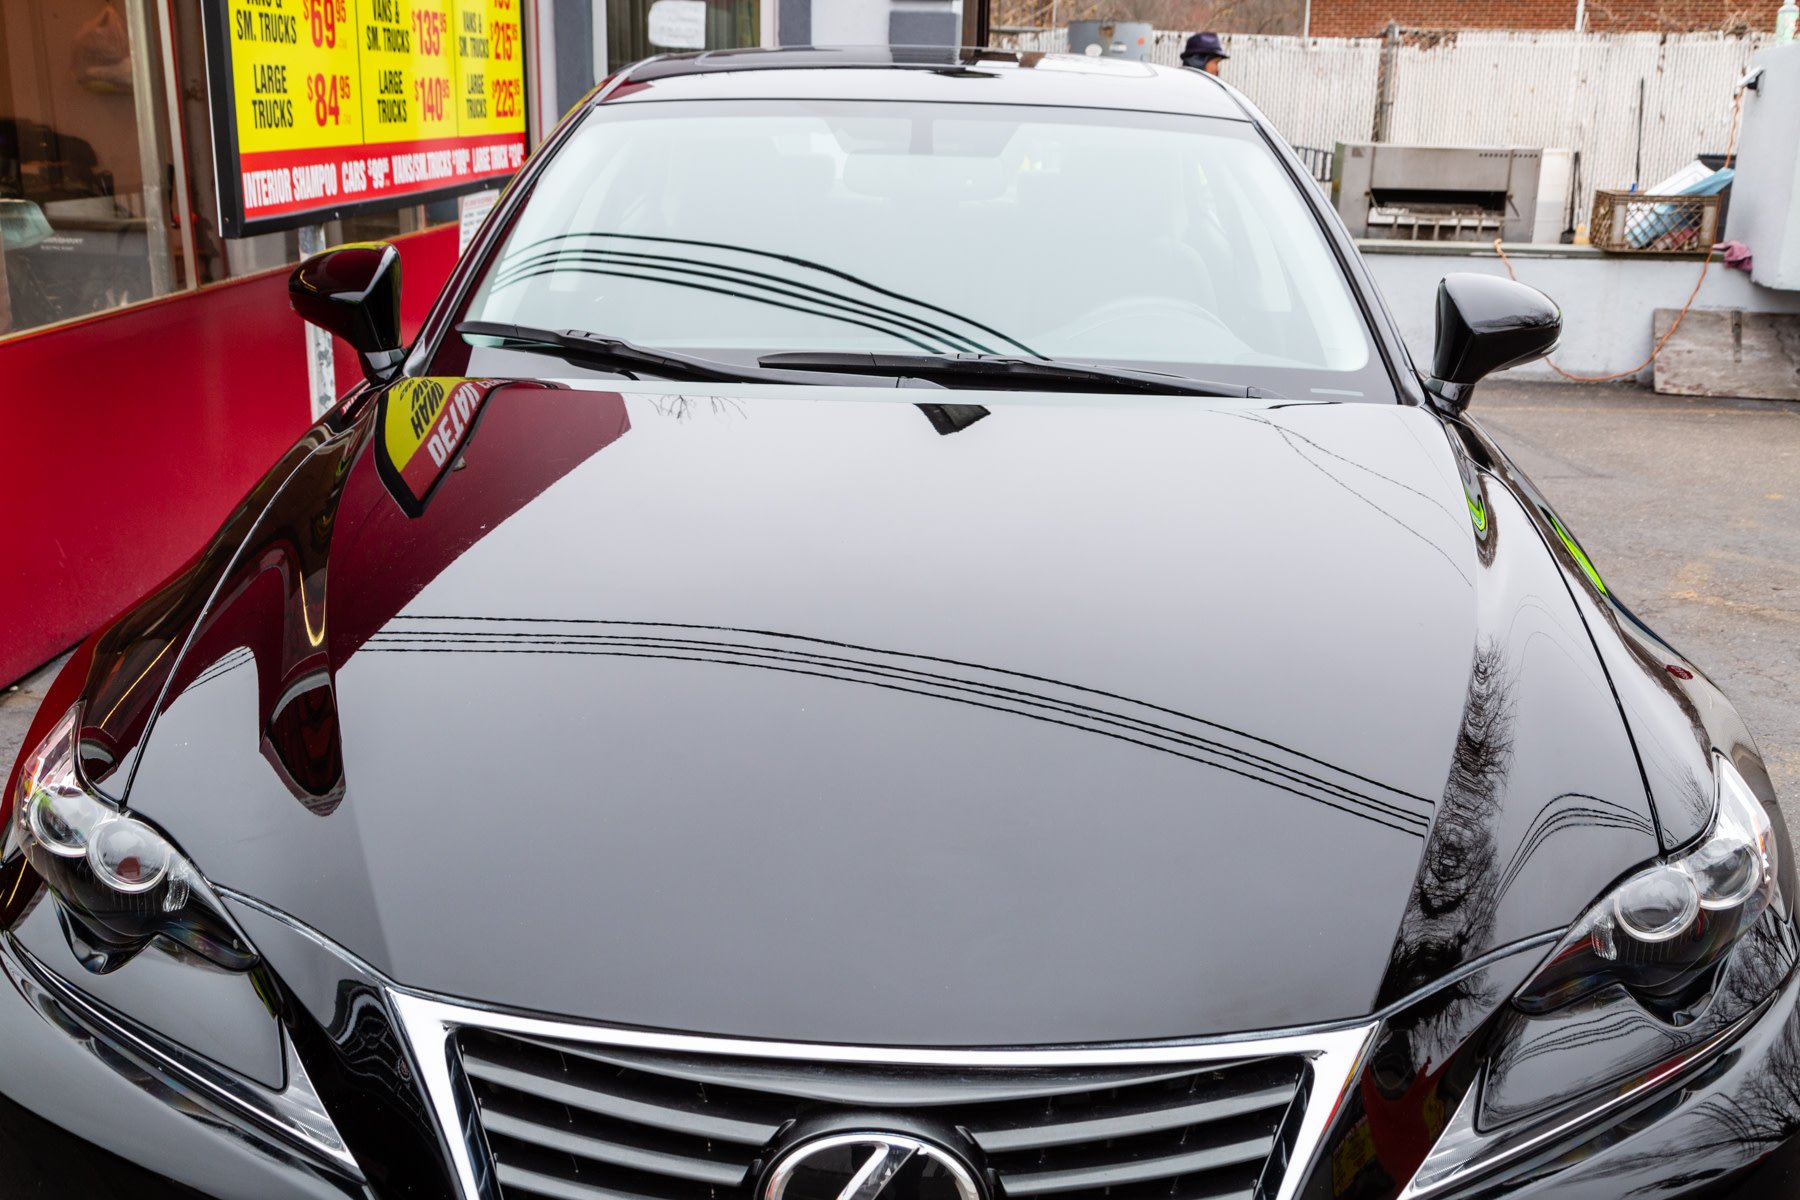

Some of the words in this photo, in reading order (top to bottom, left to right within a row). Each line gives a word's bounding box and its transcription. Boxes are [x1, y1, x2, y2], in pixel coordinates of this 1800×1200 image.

[372, 0, 392, 23] VANS
[463, 10, 477, 33] VANS
[236, 9, 257, 41] SM.
[258, 12, 298, 44] TRUCKS
[366, 25, 381, 51] SM.
[382, 27, 410, 53] TRUCKS
[470, 37, 489, 58] TRUCKS
[253, 64, 288, 94] LARGE
[378, 70, 404, 94] LARGE
[467, 73, 485, 94] LARGE
[252, 98, 294, 129] TRUCKS
[377, 98, 408, 123] TRUCKS
[466, 98, 487, 119] TRUCKS
[242, 168, 293, 209] INTERIOR
[292, 162, 338, 202] SHAMPOO
[341, 159, 367, 194] CARS
[472, 145, 491, 173] LARGE
